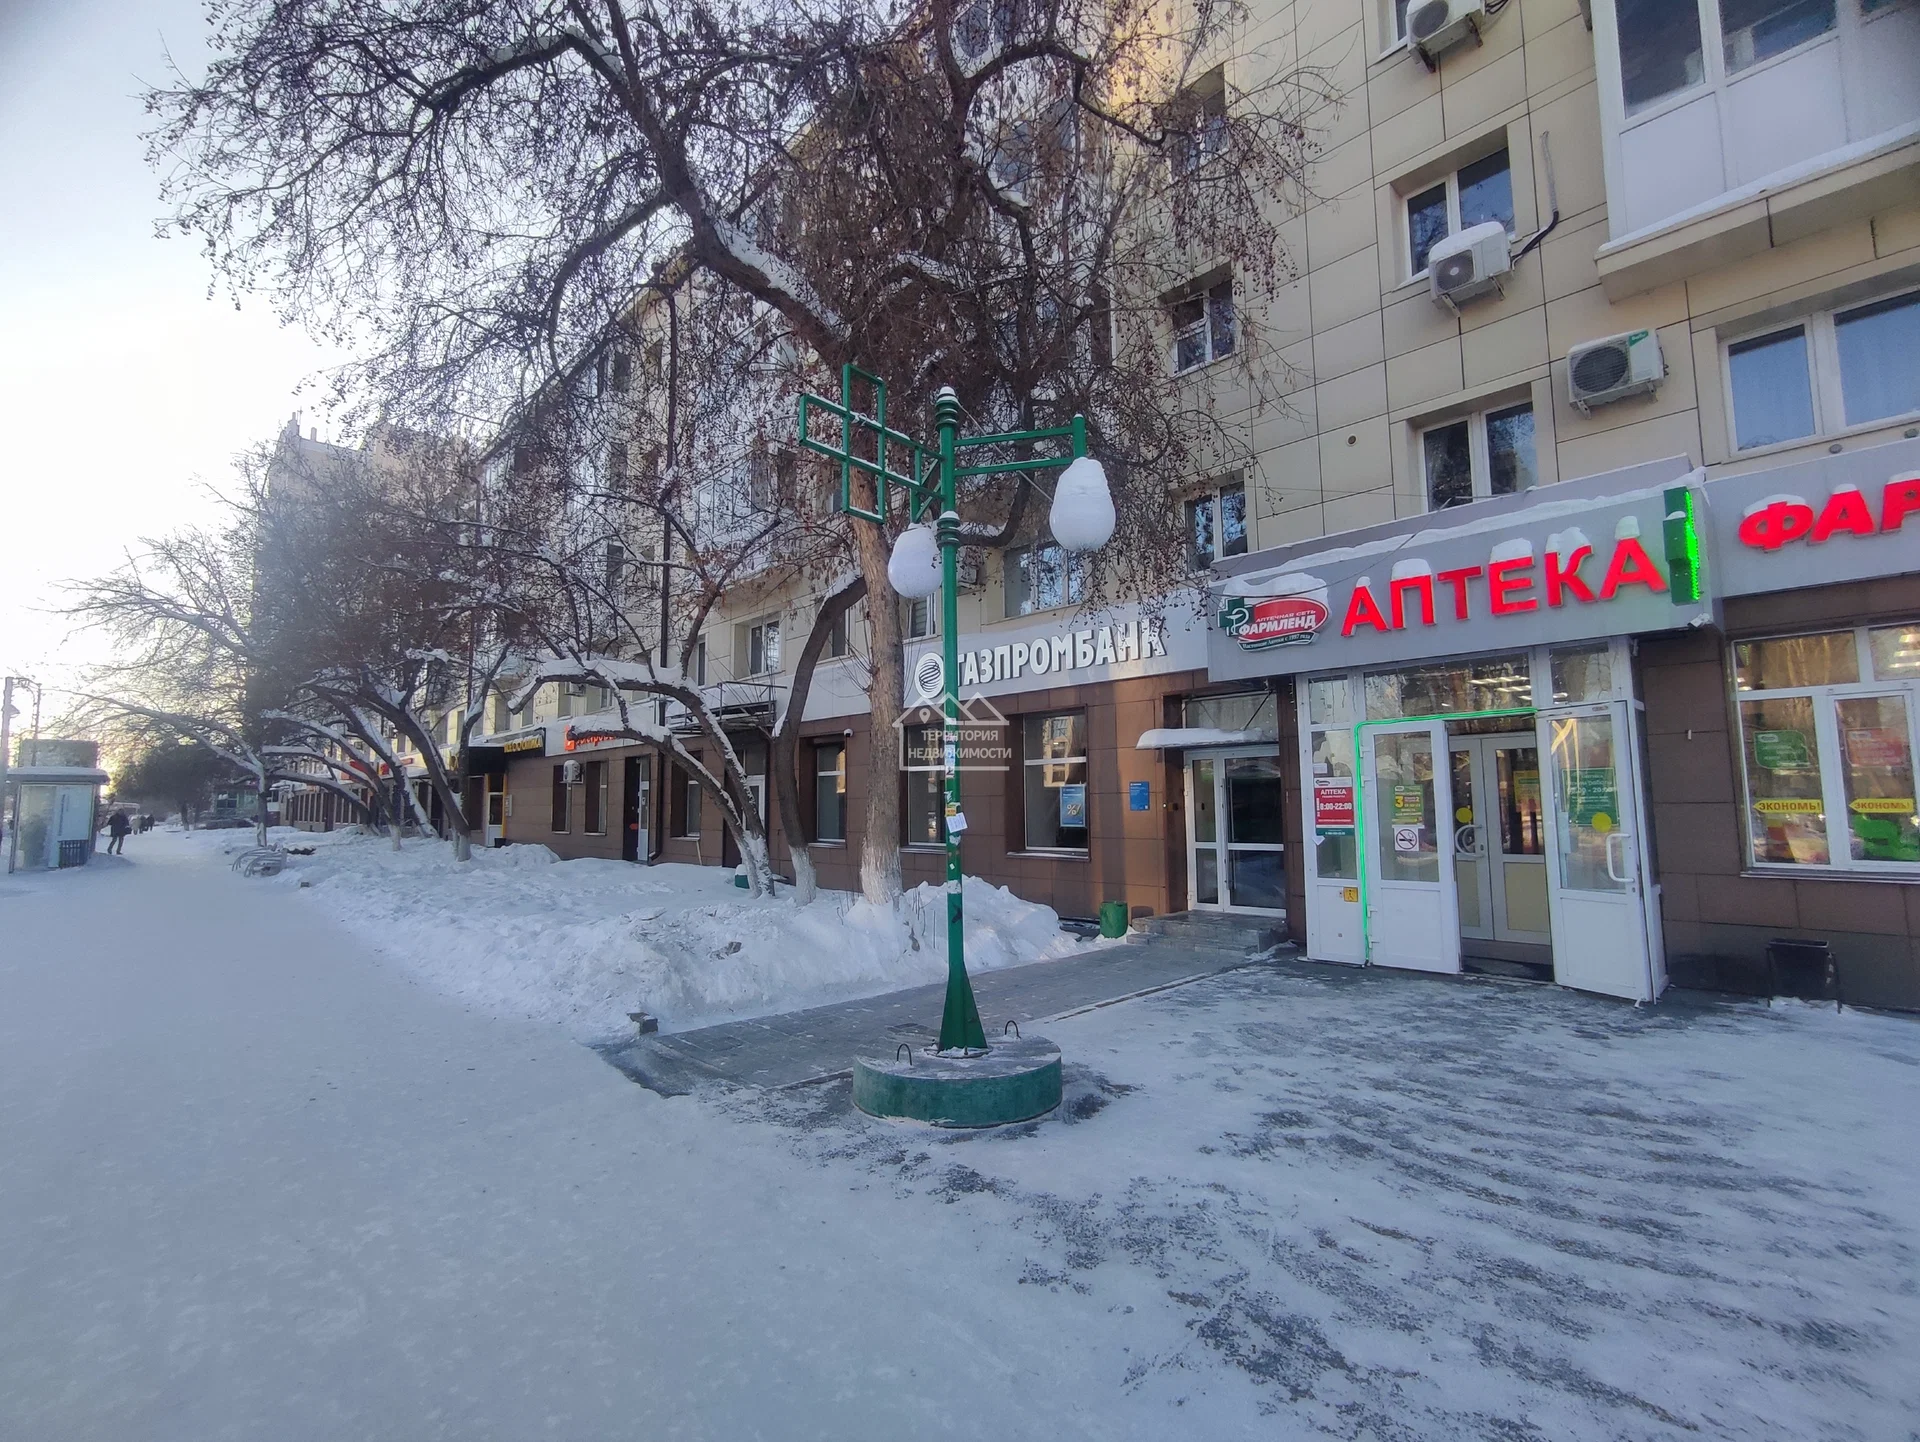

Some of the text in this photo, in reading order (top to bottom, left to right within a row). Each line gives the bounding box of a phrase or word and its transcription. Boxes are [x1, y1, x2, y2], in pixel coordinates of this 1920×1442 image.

[1341, 538, 1668, 637] АПТЕКА
[1256, 613, 1294, 623] АПТЕЧНАЯ
[1238, 614, 1317, 635] ФАРМЛЕНД
[1394, 795, 1404, 808] 3
[1759, 802, 1821, 811] ЭКОНОМЬ!
[1854, 801, 1910, 810] ЭКОНОМЬ!
